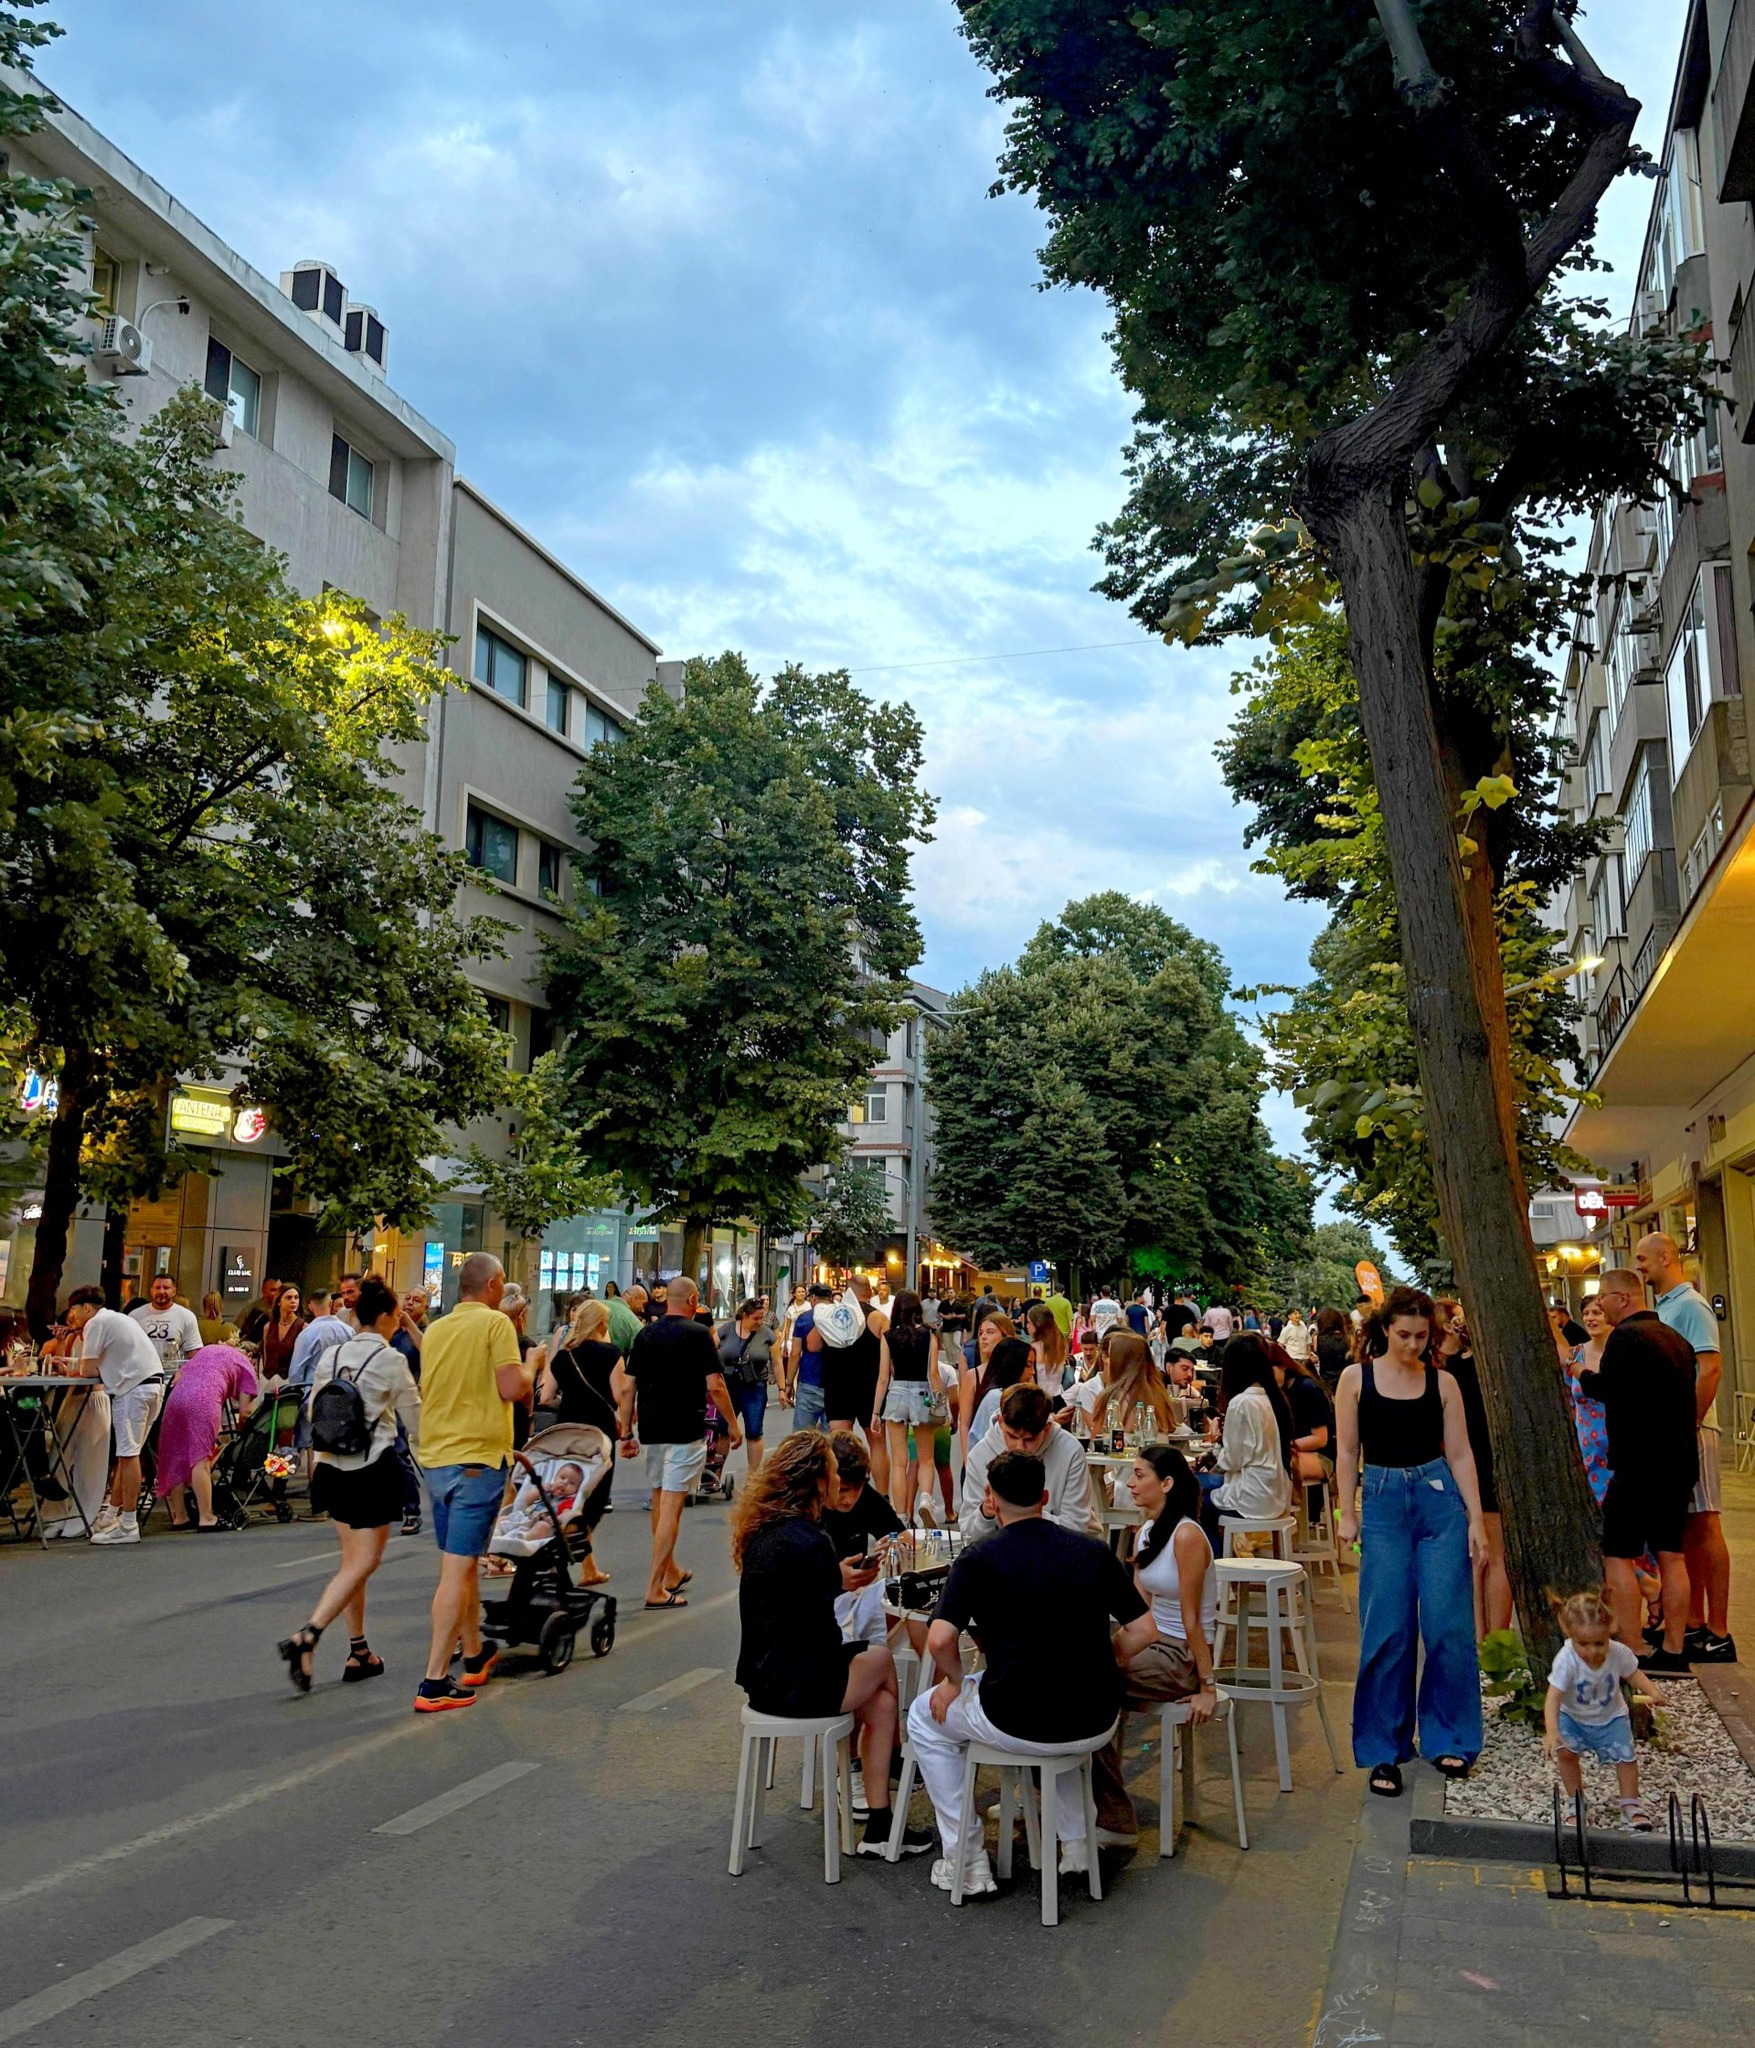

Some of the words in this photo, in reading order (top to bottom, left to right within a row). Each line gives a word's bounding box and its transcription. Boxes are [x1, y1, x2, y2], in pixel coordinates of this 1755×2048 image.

[179, 1100, 221, 1118] ANTENA
[1034, 1264, 1043, 1276] P
[147, 1323, 169, 1339] 23
